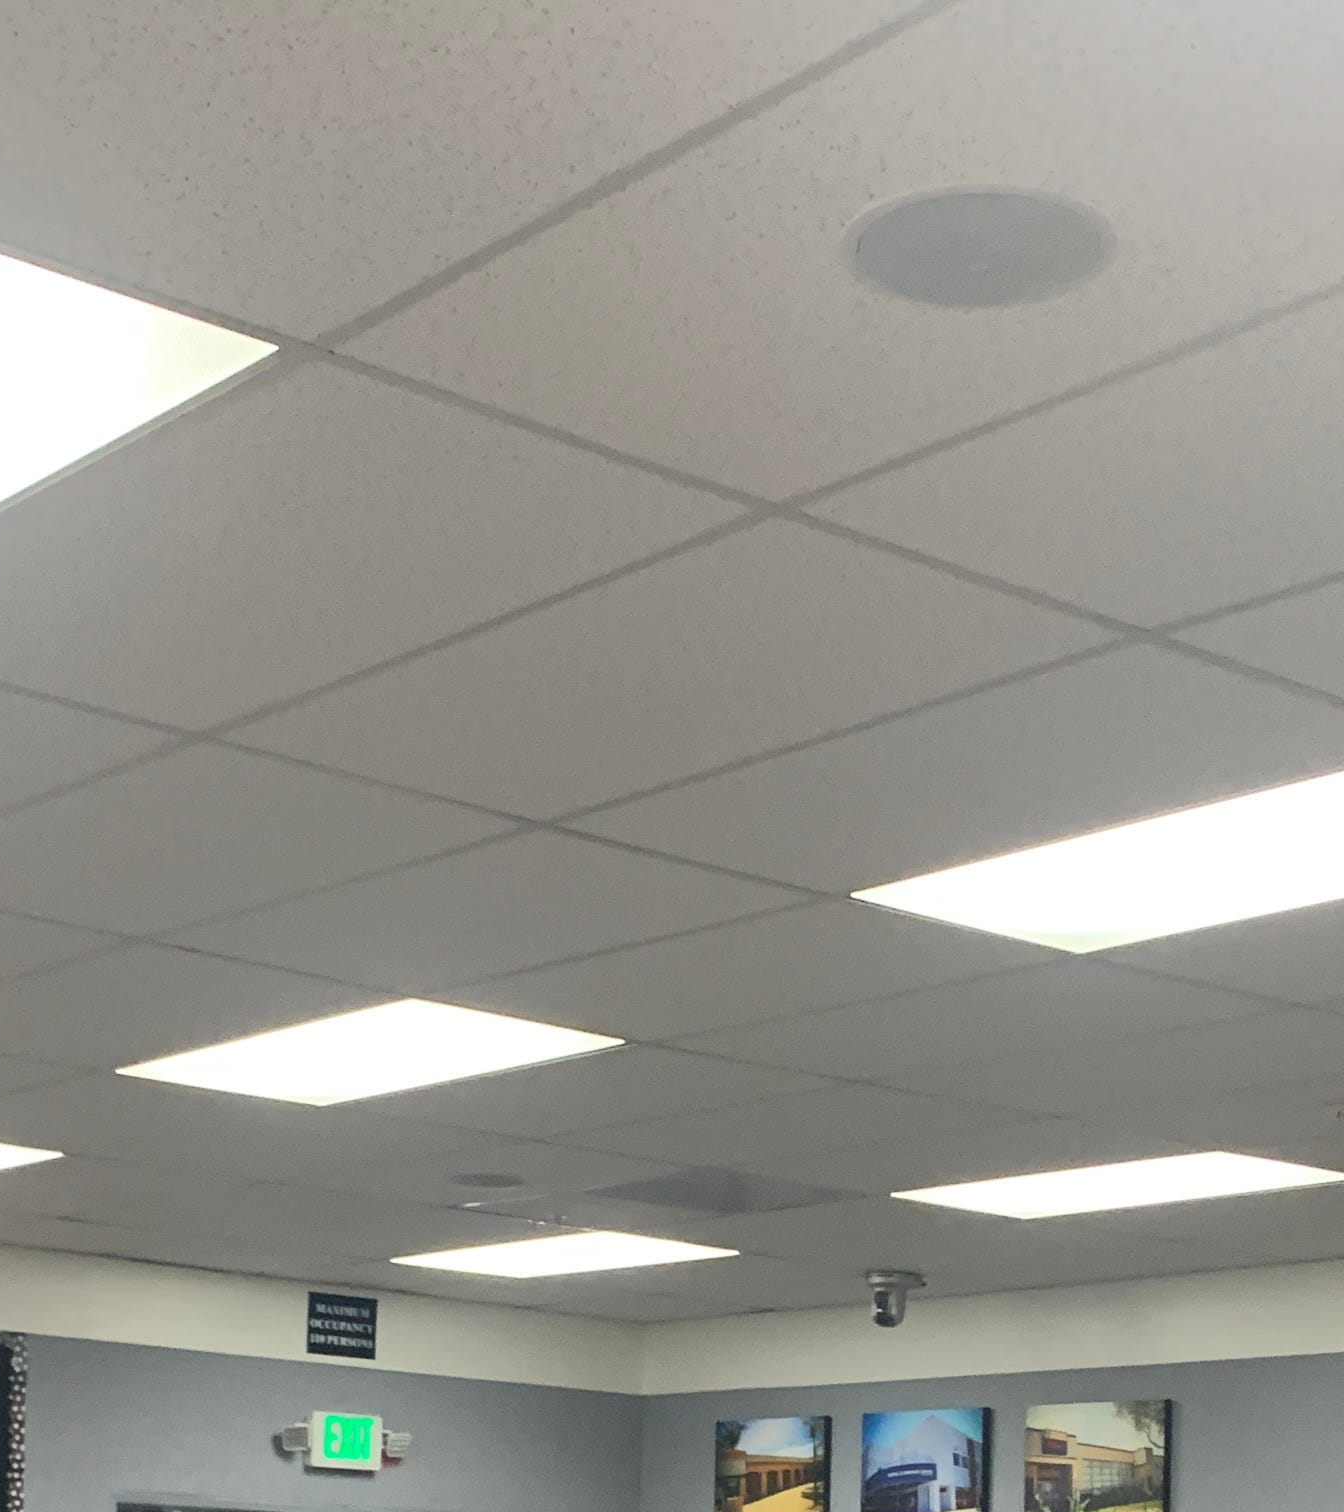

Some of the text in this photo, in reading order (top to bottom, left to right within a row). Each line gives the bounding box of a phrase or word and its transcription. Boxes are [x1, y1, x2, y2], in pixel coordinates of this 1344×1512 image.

[316, 1303, 370, 1318] MAXIMUM
[310, 1318, 373, 1334] OCCUPANCY
[327, 1334, 373, 1349] PERSONS
[324, 1414, 375, 1461] EXIT
